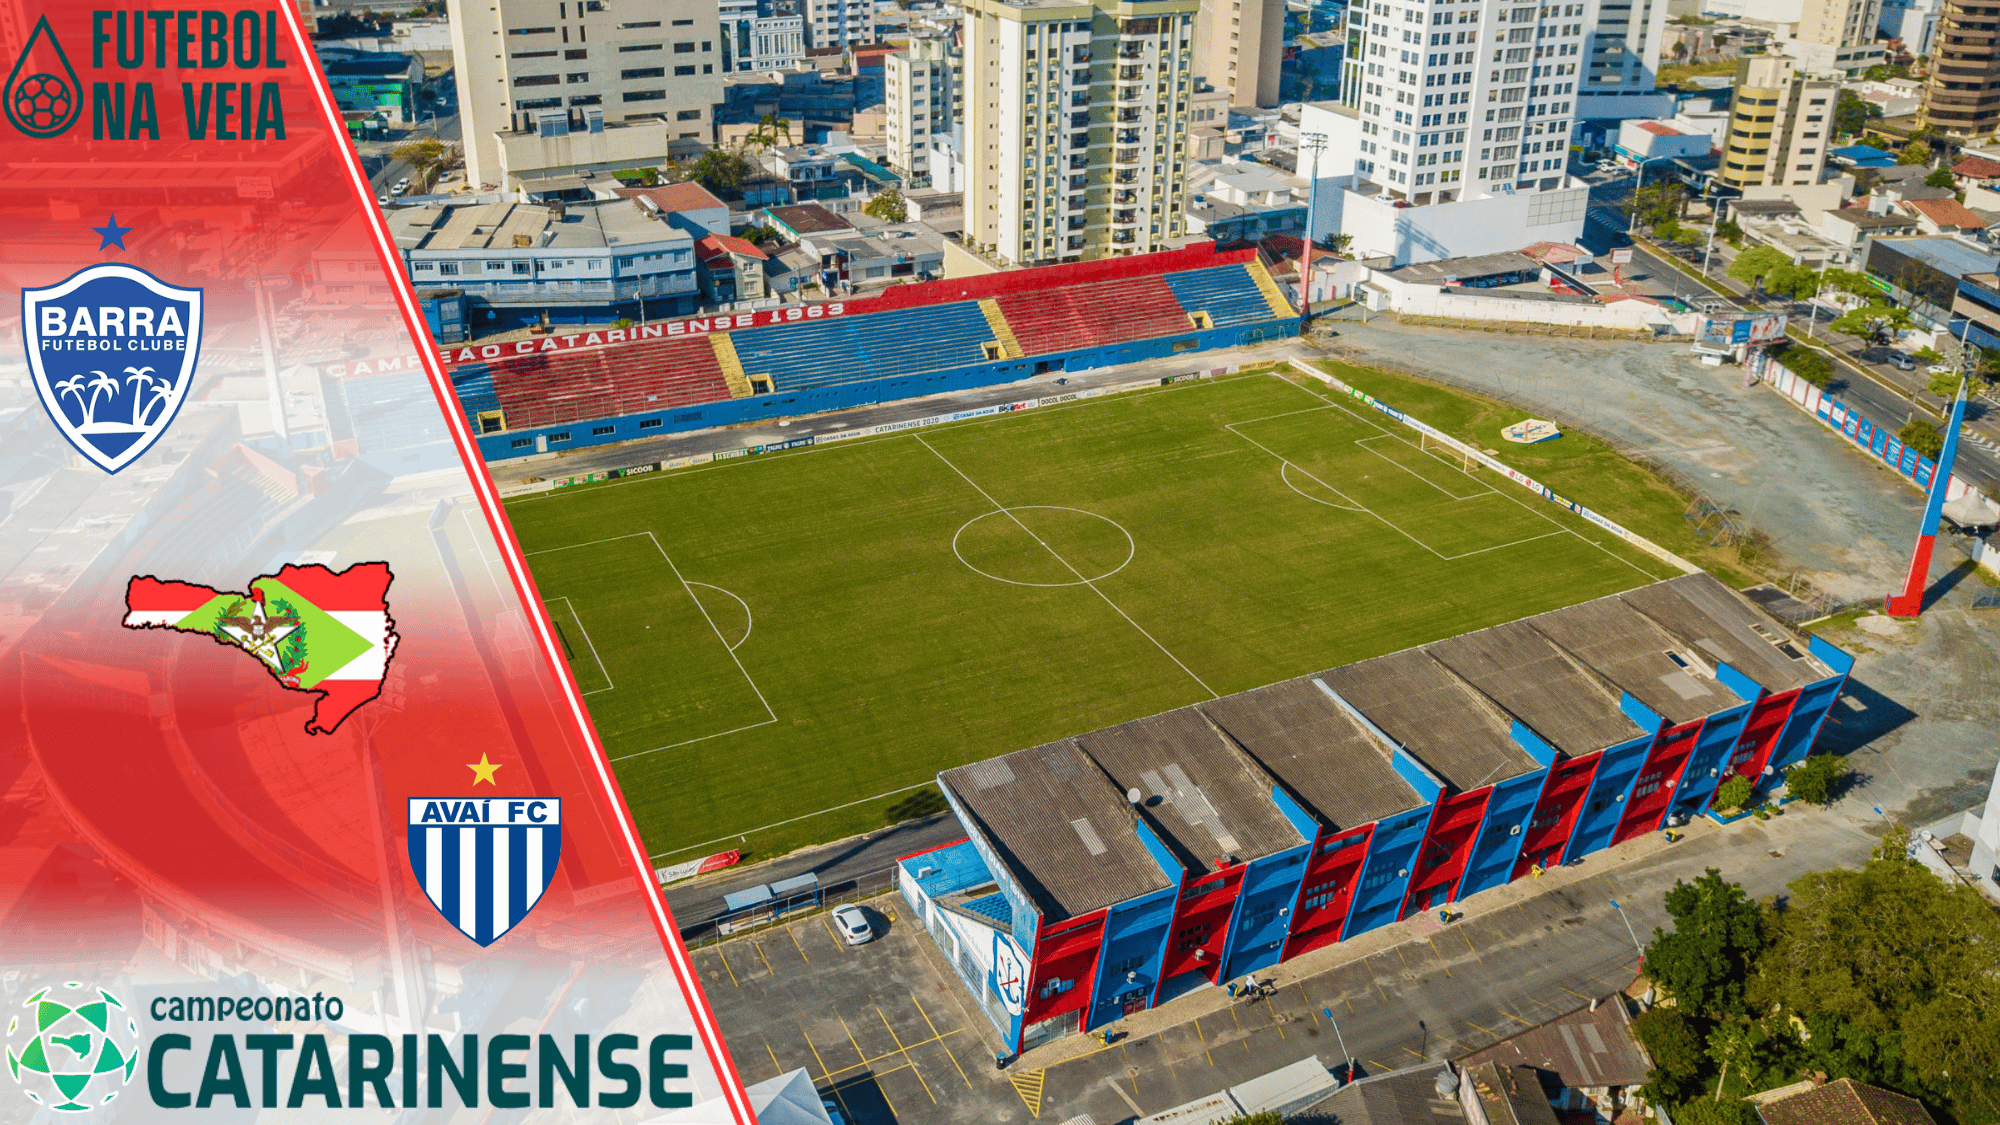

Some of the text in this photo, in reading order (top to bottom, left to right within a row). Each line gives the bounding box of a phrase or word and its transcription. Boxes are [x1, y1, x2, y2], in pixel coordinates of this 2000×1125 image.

[515, 314, 753, 354] CATARINENSE
[769, 303, 845, 323] 1963
[1041, 393, 1077, 405] DOCOL DOCOL
[875, 417, 940, 433] CATARINENSE 2020
[626, 464, 654, 475] SICOOB
[1515, 473, 1524, 482] LG
[1532, 483, 1540, 492] LG
